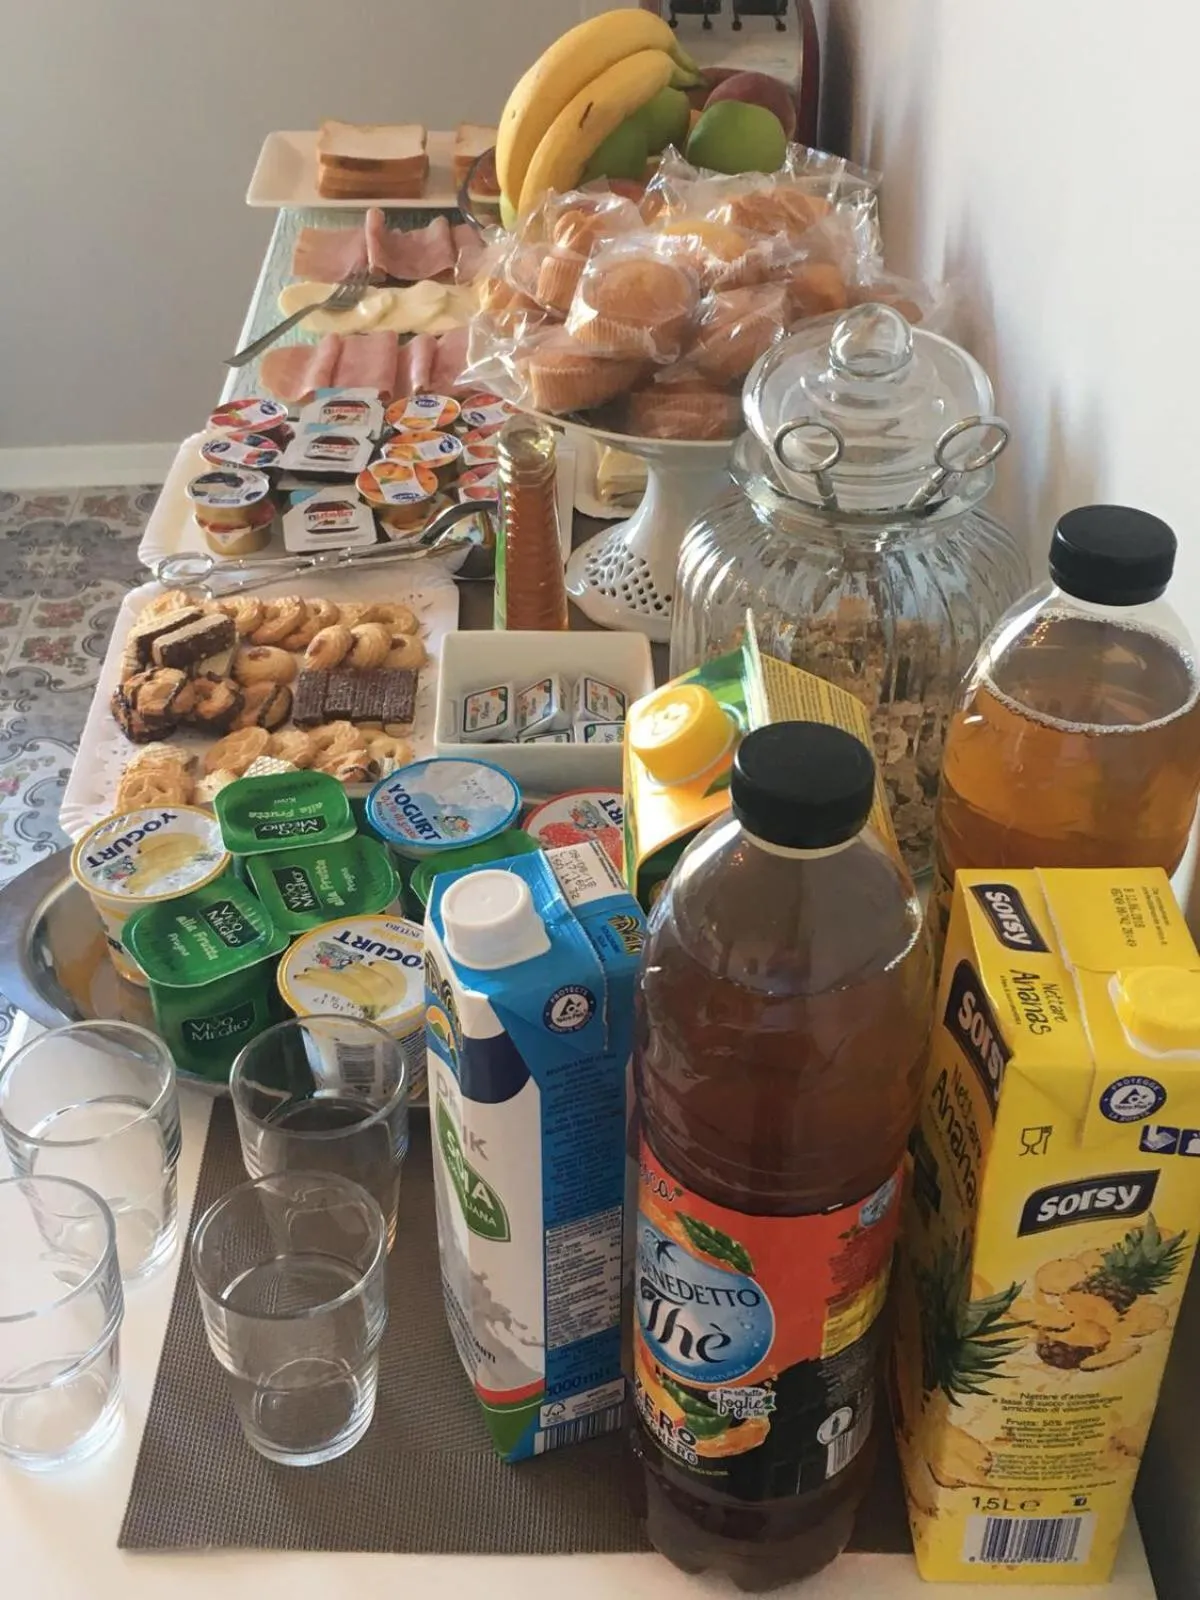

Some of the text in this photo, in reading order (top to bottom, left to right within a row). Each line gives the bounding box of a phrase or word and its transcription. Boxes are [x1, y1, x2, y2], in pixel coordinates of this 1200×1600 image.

[388, 783, 442, 840] YOGURT
[86, 812, 178, 869] YOGURT
[984, 891, 1032, 946] sorsy
[333, 930, 425, 971] OGURT
[1009, 969, 1052, 1036] Ananas
[1036, 1184, 1142, 1222] sorsy
[720, 1392, 762, 1419] foglie
